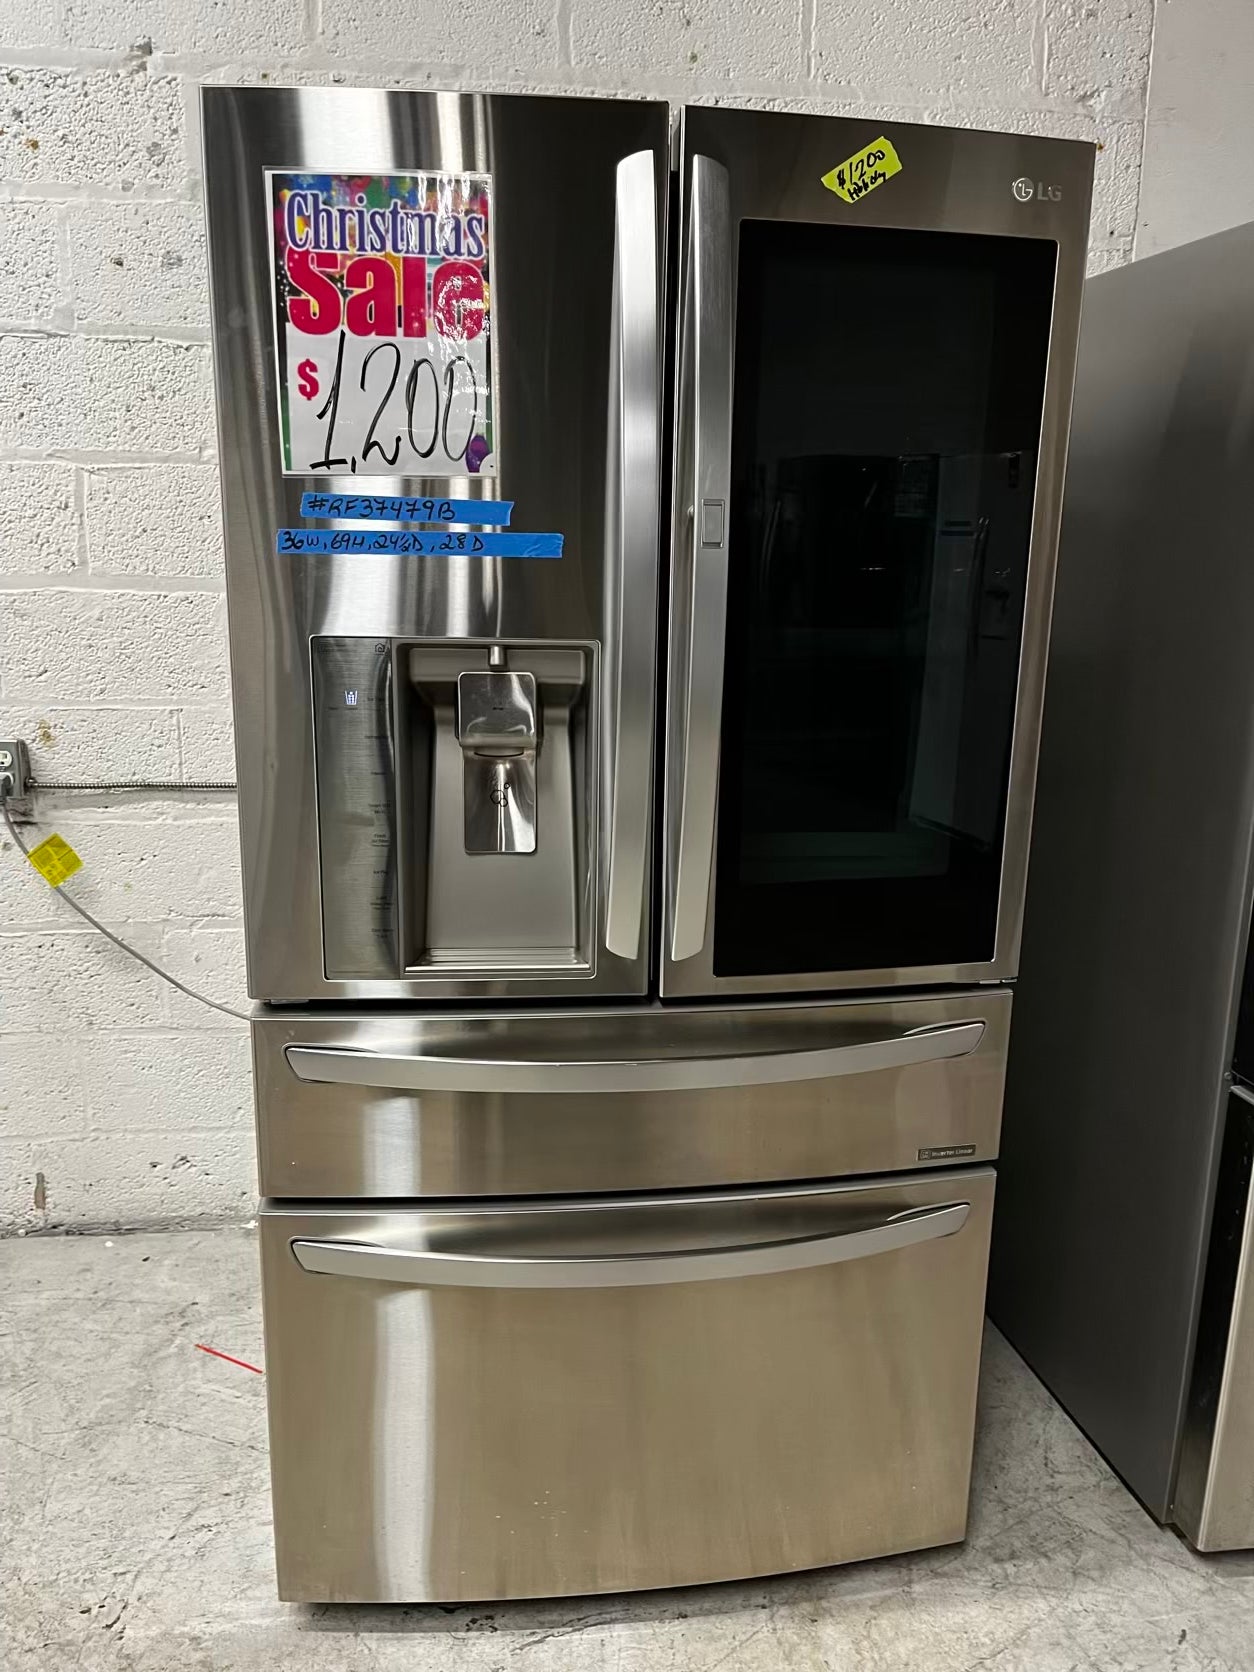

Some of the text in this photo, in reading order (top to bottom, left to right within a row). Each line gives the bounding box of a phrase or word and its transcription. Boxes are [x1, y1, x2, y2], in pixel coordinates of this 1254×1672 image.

[837, 150, 885, 190] $1200
[286, 191, 486, 257] Christmas
[286, 249, 486, 340] Sale
[308, 496, 456, 521] #RF37479B
